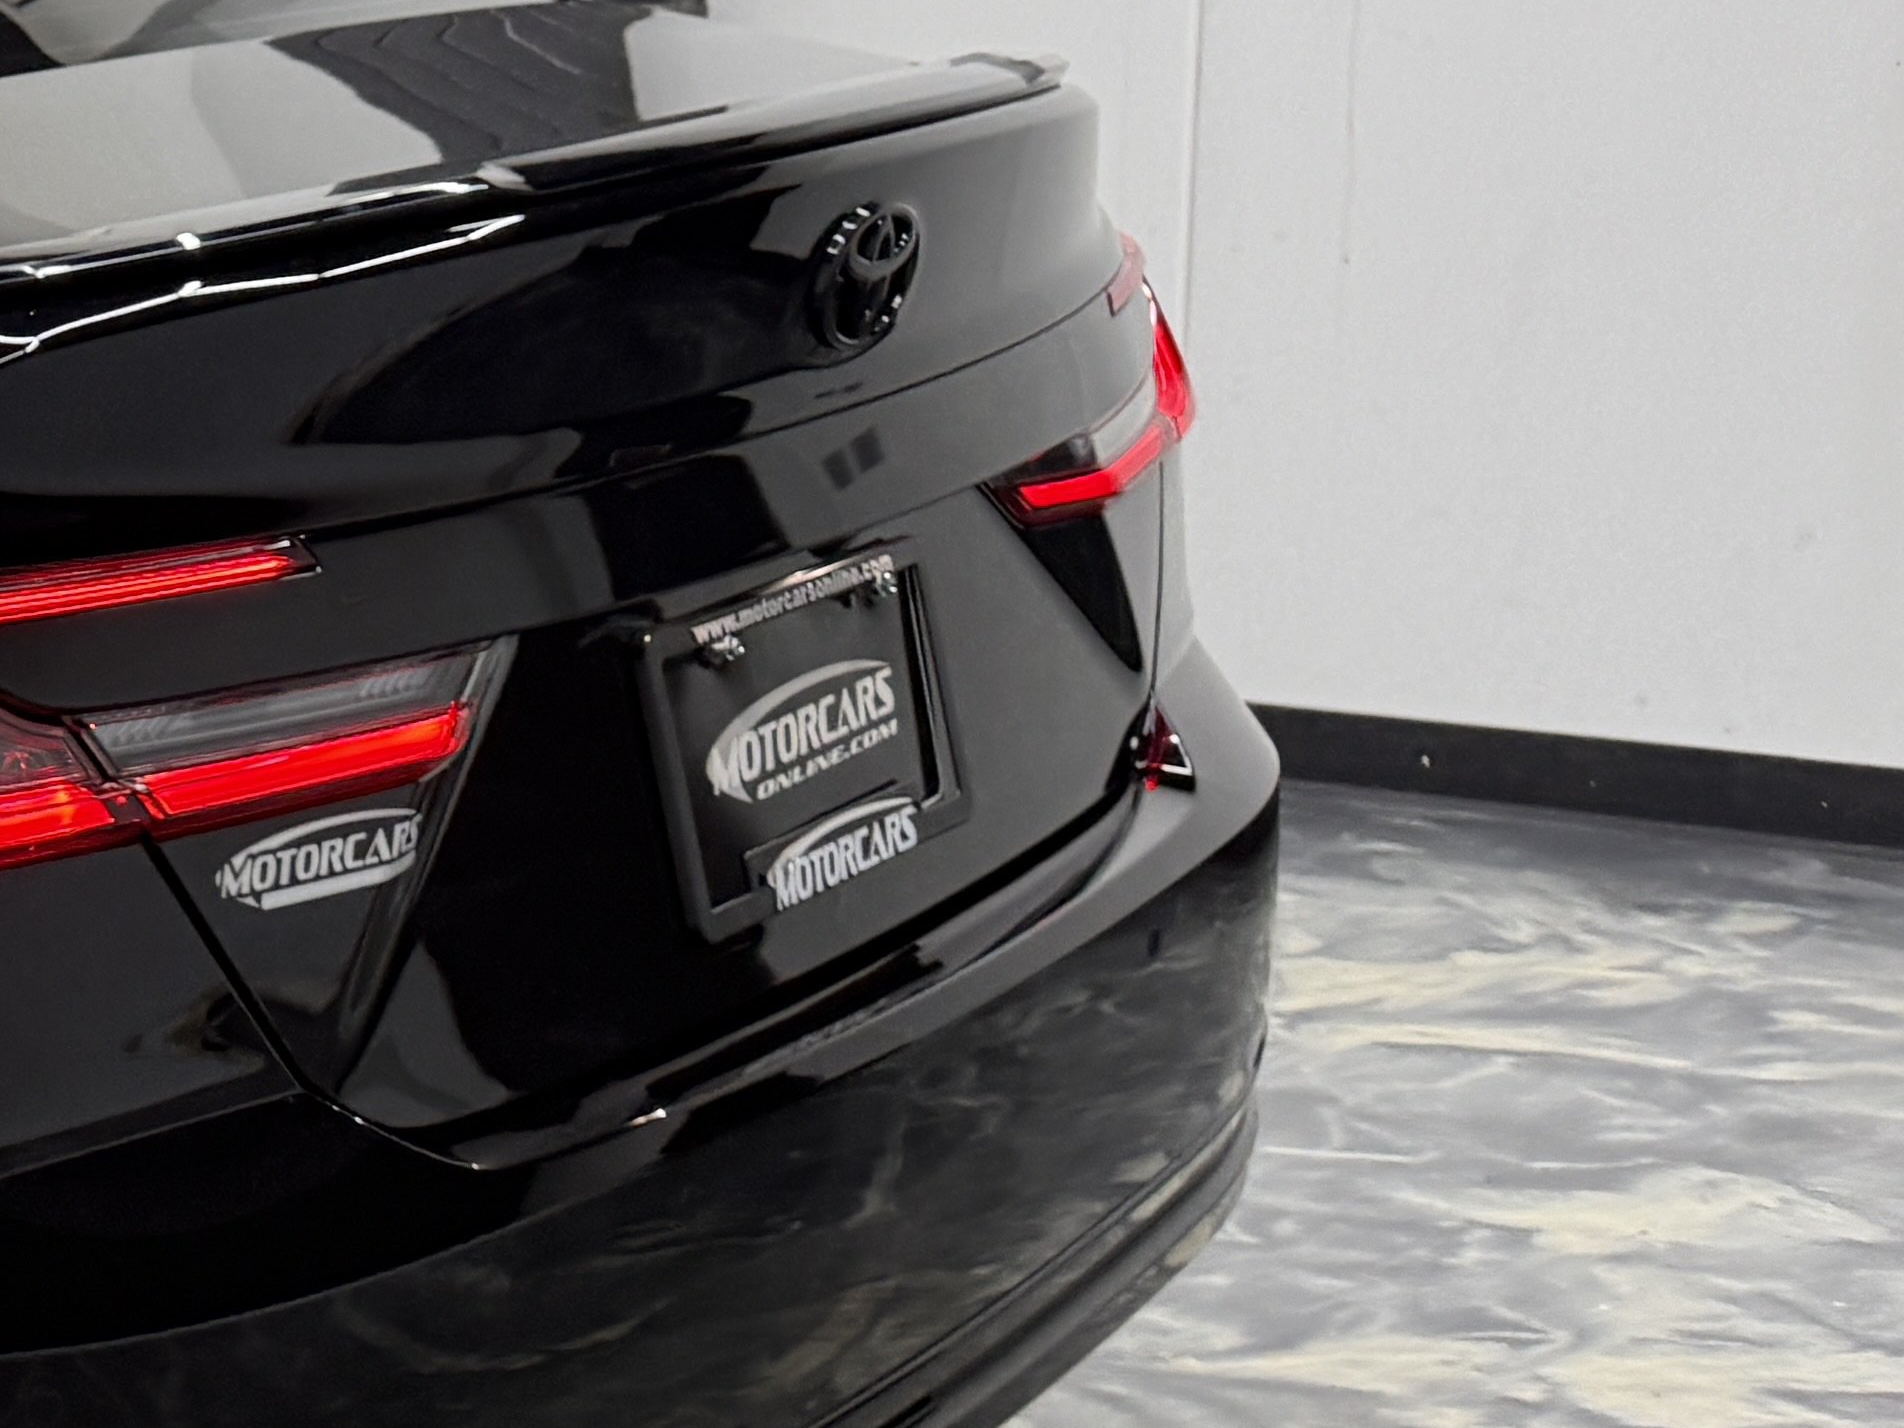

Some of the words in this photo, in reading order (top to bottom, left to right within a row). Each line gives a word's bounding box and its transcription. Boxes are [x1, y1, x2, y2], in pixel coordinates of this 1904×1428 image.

[710, 666, 895, 796] MOTORCARS
[757, 719, 897, 800] ONLINE.COM
[220, 813, 423, 899] MOTORCARS
[776, 804, 918, 911] MOTORCARS
